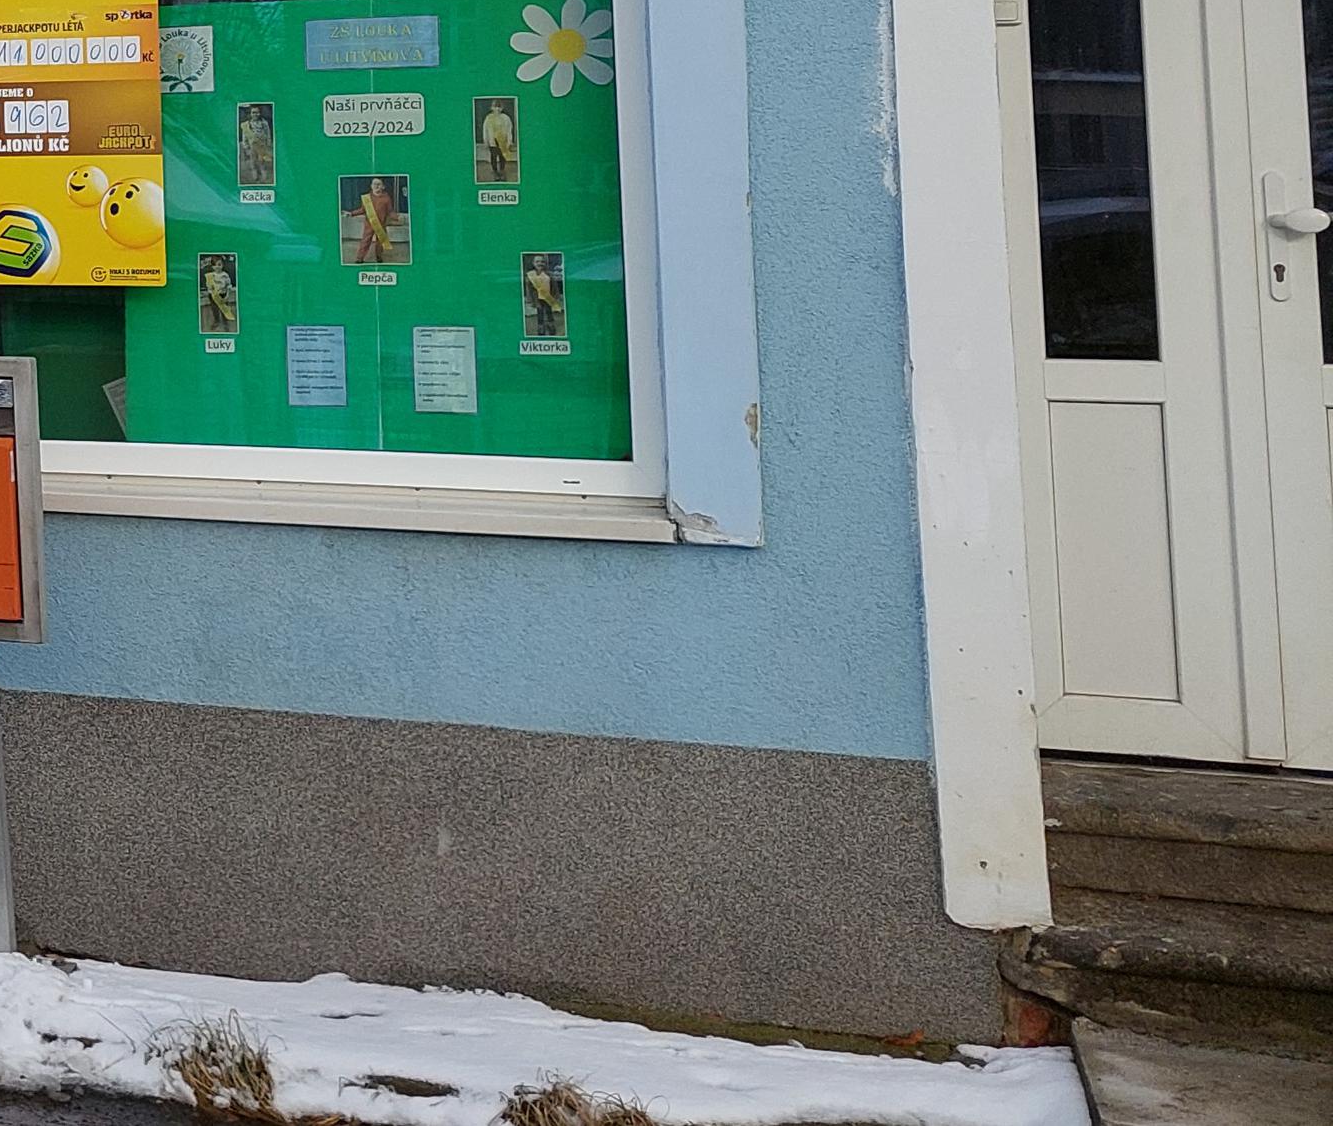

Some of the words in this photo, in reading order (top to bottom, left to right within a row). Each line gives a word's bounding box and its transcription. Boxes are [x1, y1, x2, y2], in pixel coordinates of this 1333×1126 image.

[142, 51, 155, 63] KČ
[325, 98, 355, 113] Naši
[360, 97, 423, 114] prvňáčci
[107, 124, 140, 137] EURO
[333, 120, 414, 137] 2023/2024
[48, 135, 70, 152] KČ
[98, 136, 152, 149] JACKPOT
[242, 191, 272, 202] Kačka
[480, 192, 517, 203] Elenka
[361, 272, 393, 284] Pepča
[207, 339, 233, 351] Luky
[520, 342, 569, 353] Viktorka
